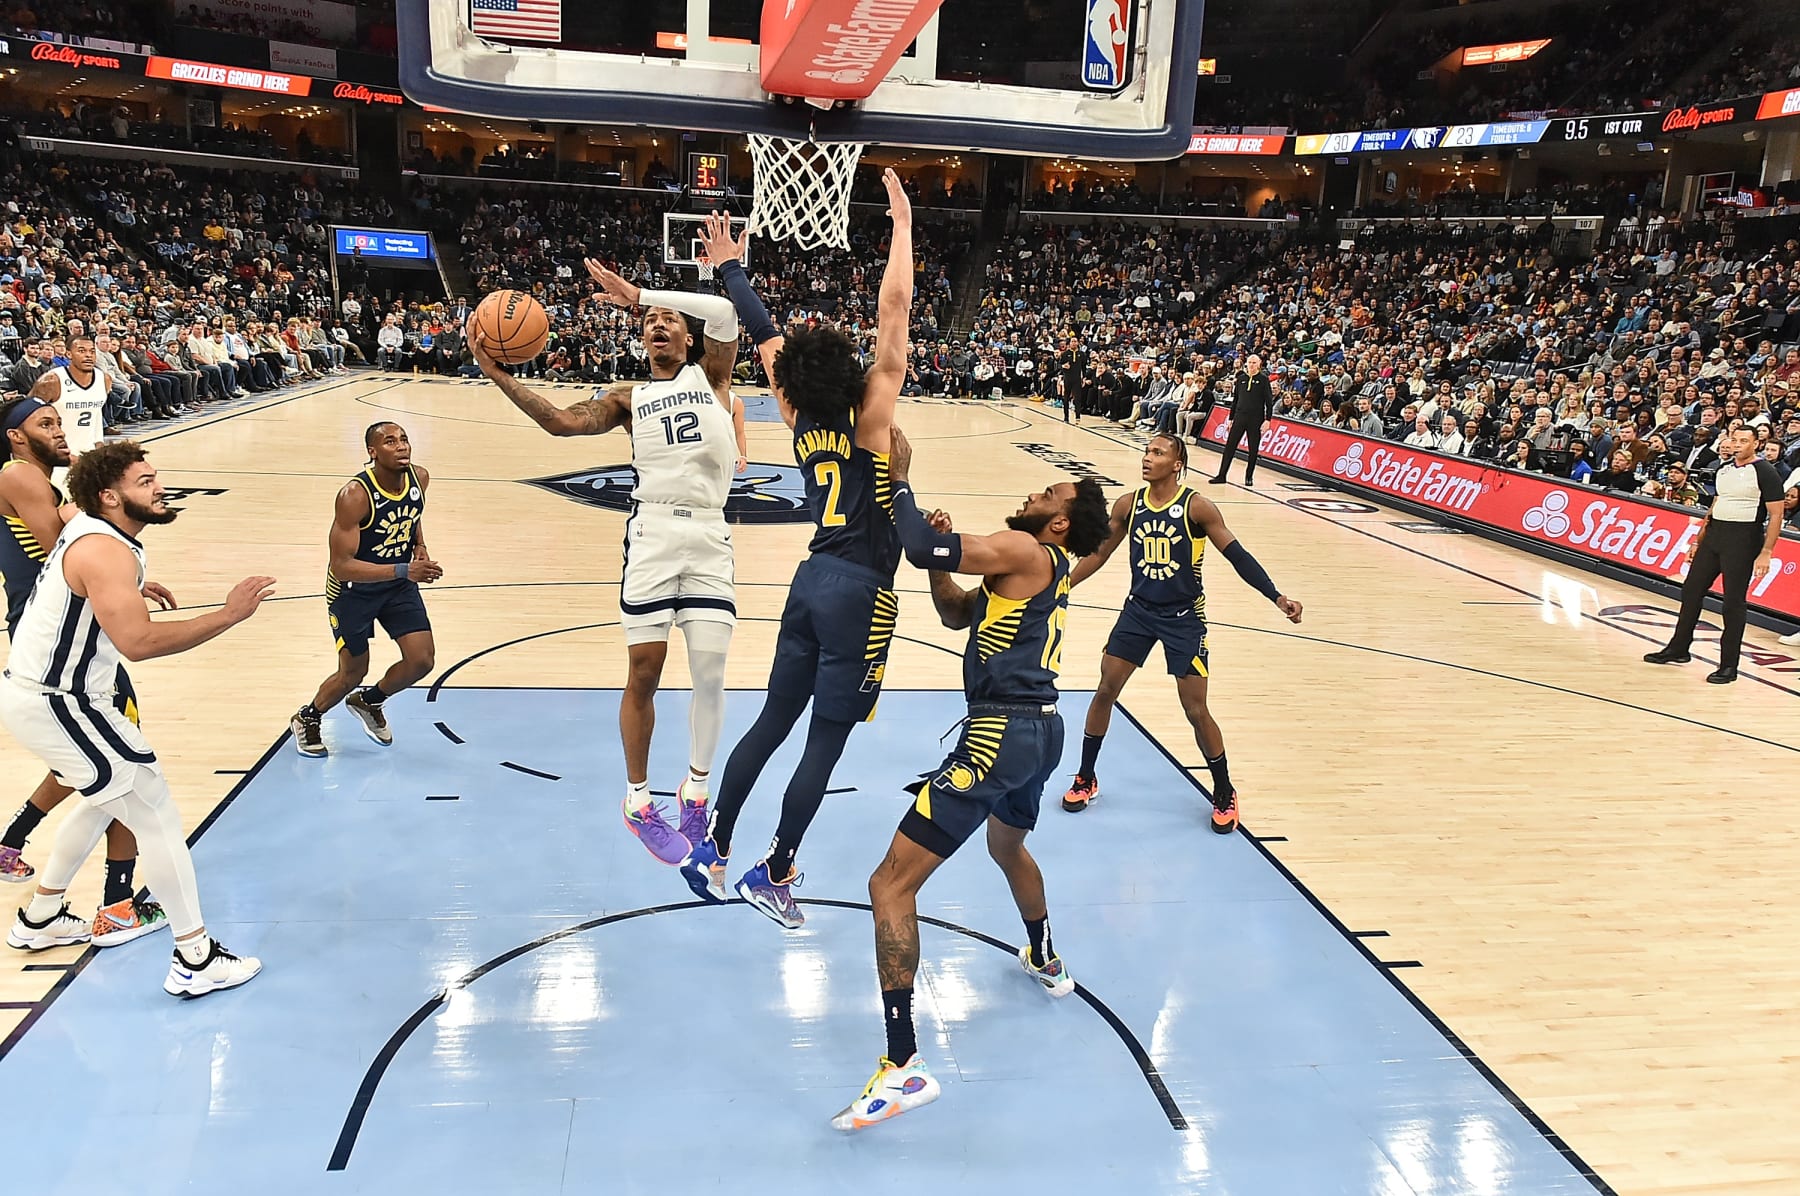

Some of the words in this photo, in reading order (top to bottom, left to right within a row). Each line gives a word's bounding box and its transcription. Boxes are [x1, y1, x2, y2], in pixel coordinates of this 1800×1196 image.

[254, 2, 288, 15] points
[290, 8, 314, 19] with
[31, 42, 82, 68] Bally
[83, 54, 120, 69] SPORTS
[171, 62, 227, 83] GRIZZLIES
[227, 69, 262, 88] GRIND
[263, 76, 291, 91] HERE
[1088, 62, 1109, 81] NBA
[333, 81, 374, 105] Bally
[374, 92, 403, 105] SPORTS
[1564, 119, 1589, 140] 9.5
[1622, 119, 1643, 134] QTR
[1662, 106, 1703, 132] Bally
[1702, 107, 1735, 124] SPORTS
[1206, 137, 1240, 152] GRIND
[1237, 138, 1264, 152] HERE
[1333, 134, 1349, 151] 30
[1456, 126, 1474, 145] 23
[1580, 220, 1593, 228] 107
[637, 390, 714, 420] MEMPHIS
[77, 411, 92, 427] 2
[660, 411, 702, 445] 12
[1360, 447, 1482, 511] StateFarm
[814, 460, 847, 527] 2
[383, 518, 413, 547] 23
[1143, 536, 1171, 565] 00
[1568, 500, 1783, 597] StateF
